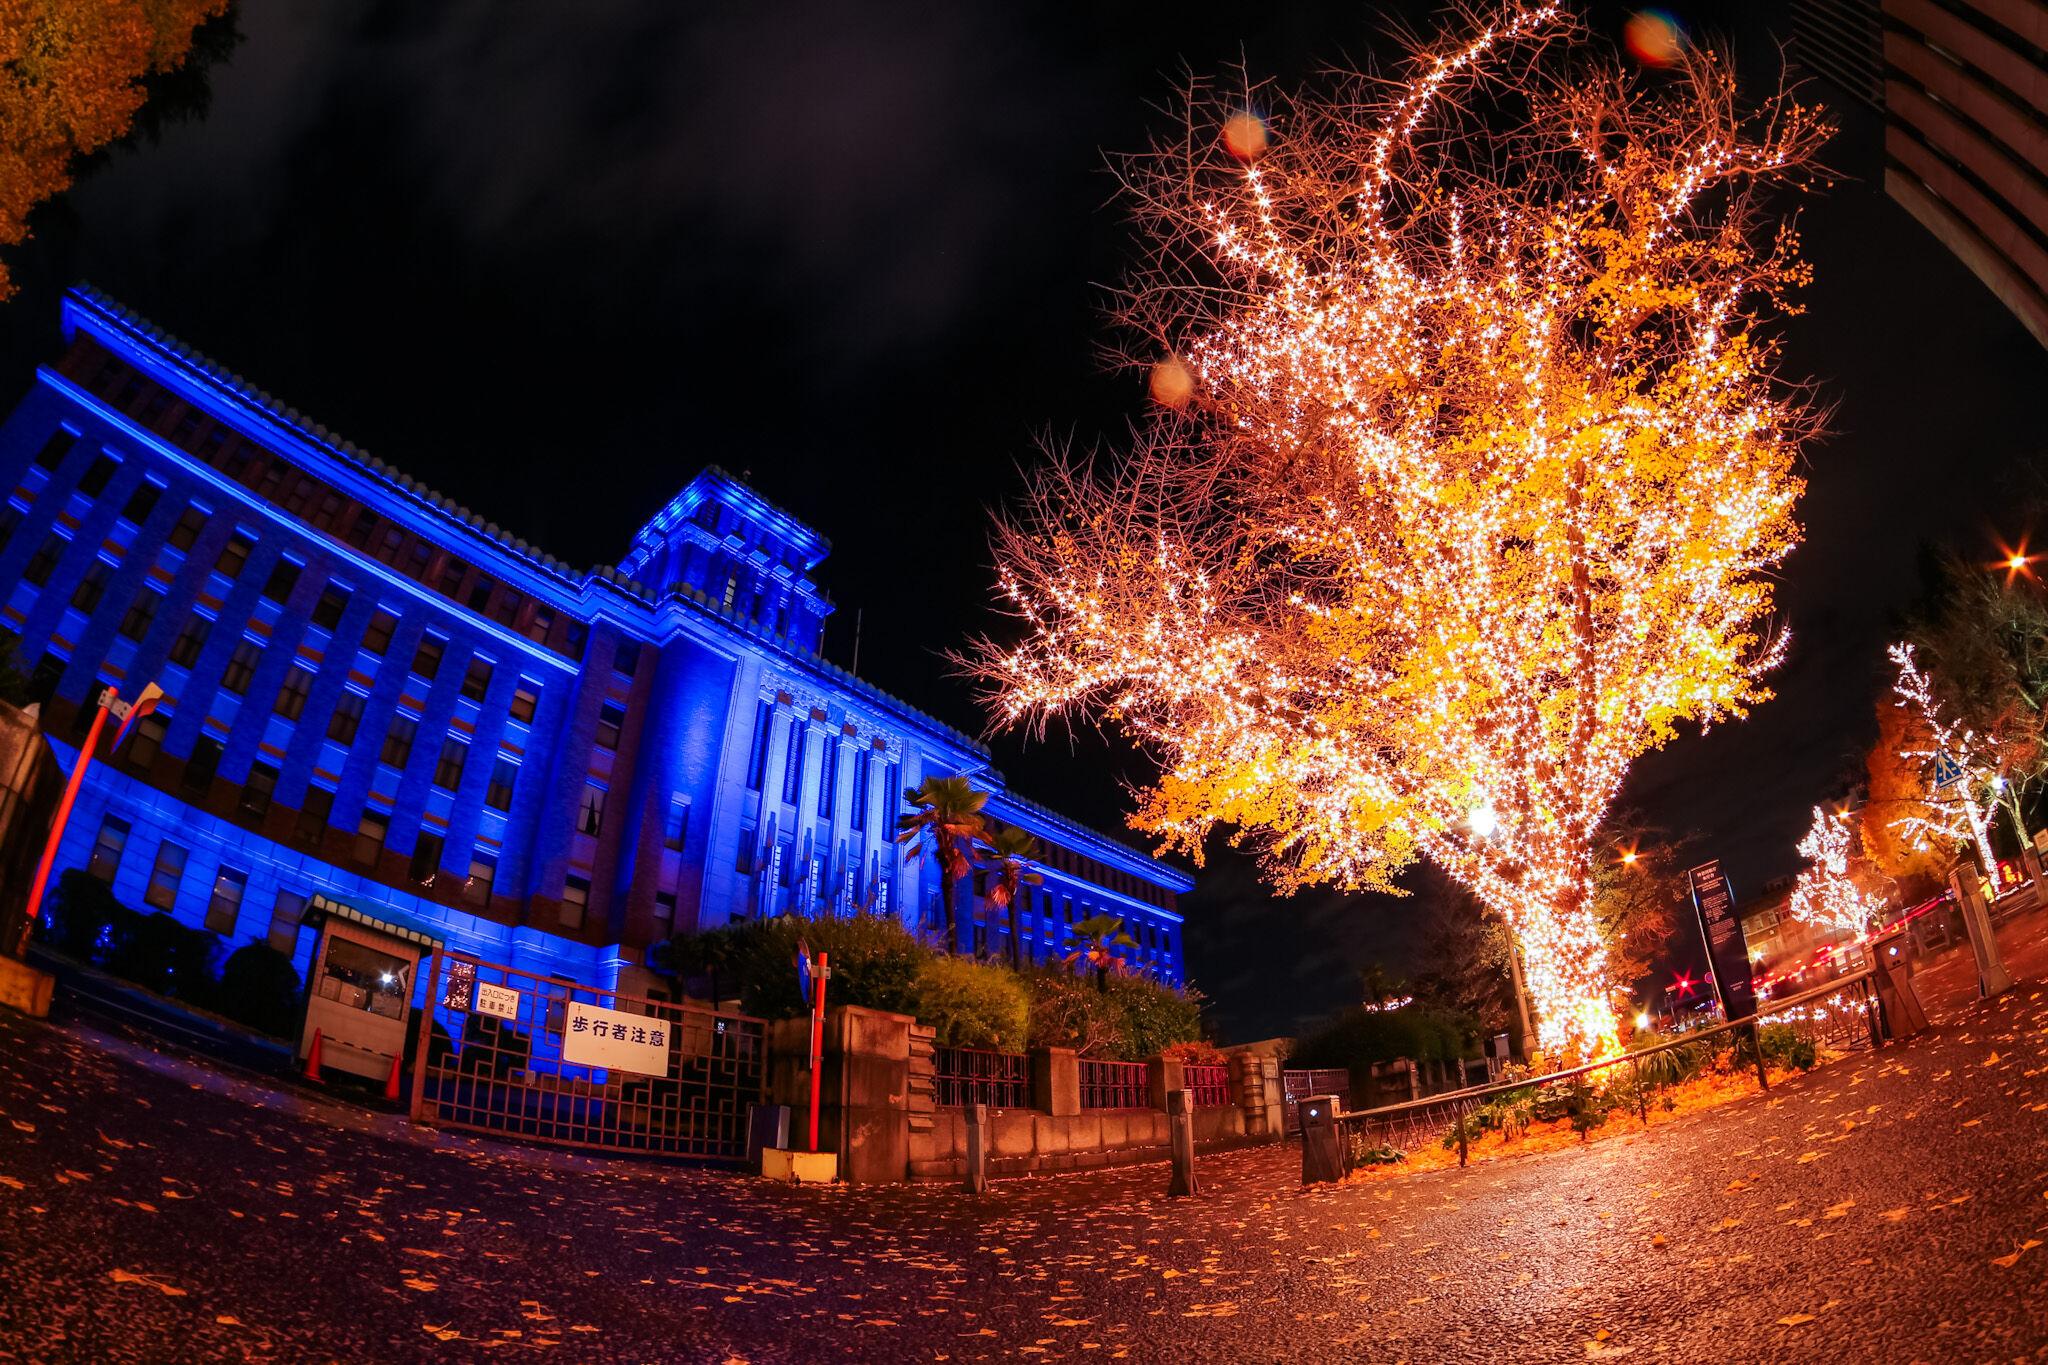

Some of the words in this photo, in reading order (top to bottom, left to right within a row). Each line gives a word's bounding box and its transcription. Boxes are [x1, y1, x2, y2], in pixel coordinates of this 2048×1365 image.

[480, 998, 514, 1015] 駐車禁止
[572, 1015, 665, 1047] 歩行者注意
